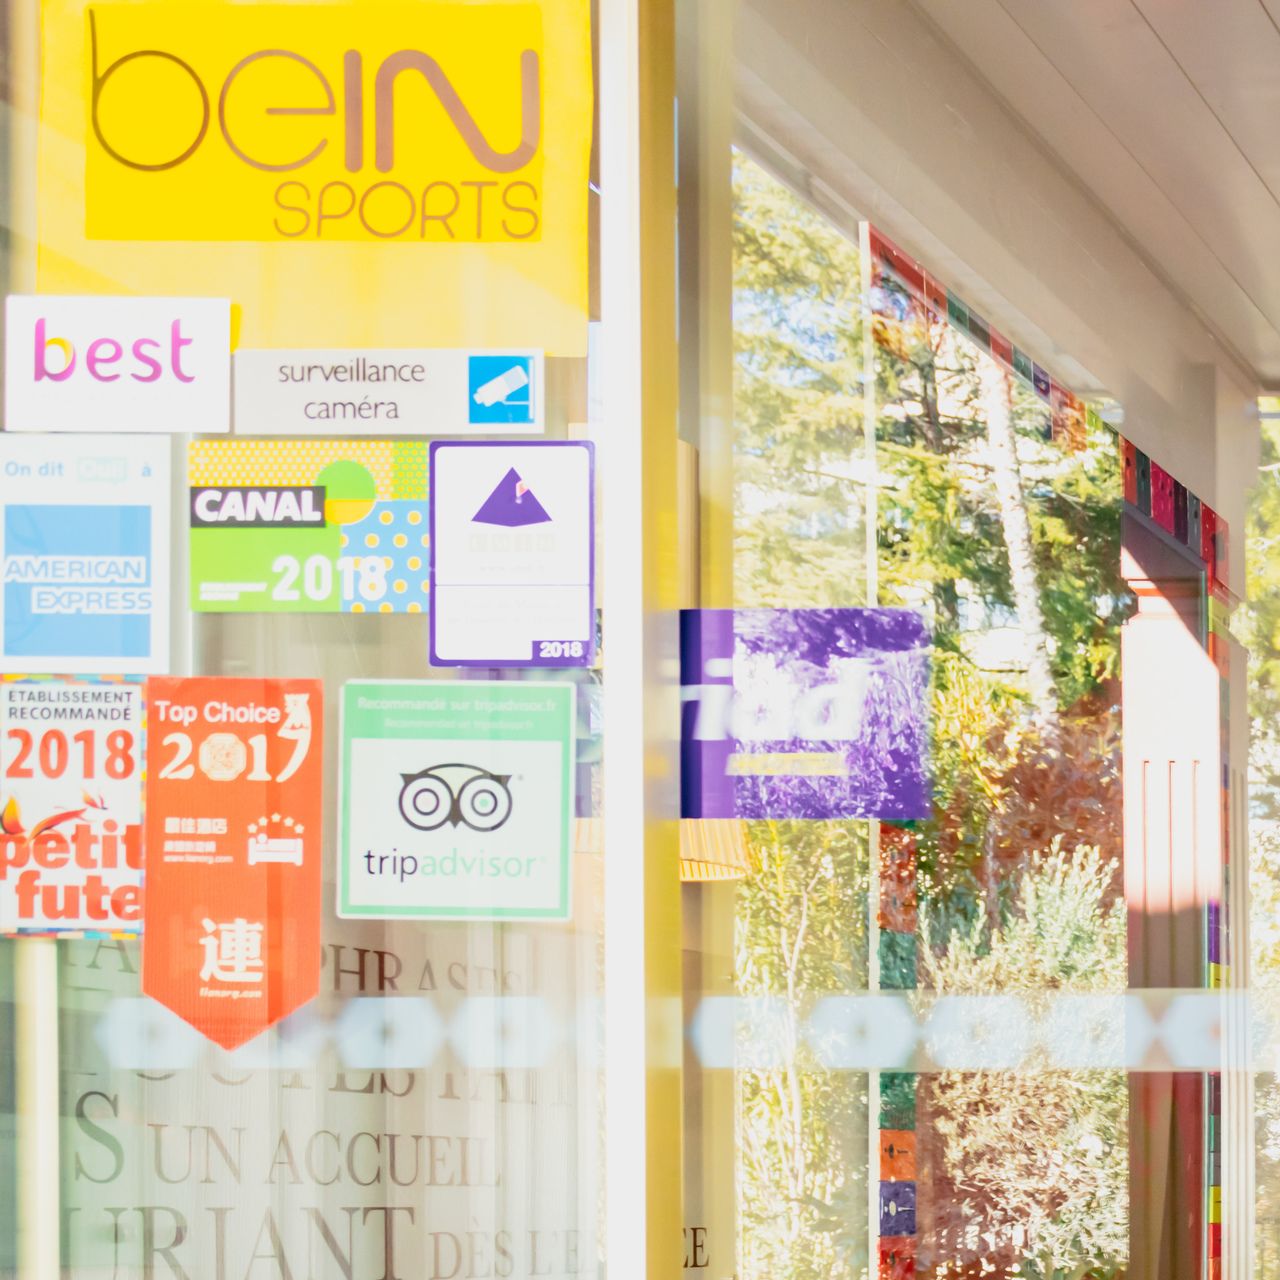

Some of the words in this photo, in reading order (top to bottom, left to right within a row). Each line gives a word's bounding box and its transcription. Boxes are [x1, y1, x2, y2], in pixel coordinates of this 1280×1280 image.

[89, 8, 541, 173] beIN
[273, 180, 539, 239] SPORTS
[33, 317, 195, 384] best
[277, 357, 426, 384] surveillance
[303, 395, 400, 421] caméra
[4, 461, 32, 478] On
[38, 461, 65, 478] dit
[194, 490, 322, 521] CANAL
[4, 560, 142, 579] AMERICAN
[271, 554, 388, 601] 2018
[36, 591, 152, 610] EXPRESS
[539, 641, 583, 658] 2018
[8, 705, 132, 721] RECOMMANDÉ
[155, 700, 198, 727] Top
[203, 700, 280, 724] Choice
[5, 728, 135, 779] 2018
[0, 819, 143, 880] petit
[364, 848, 538, 882] tripadvisor
[199, 917, 264, 982] 連
[147, 1123, 246, 1184] UN
[263, 1129, 502, 1188] ACCUEIL
[428, 1218, 515, 1280] DÈS
